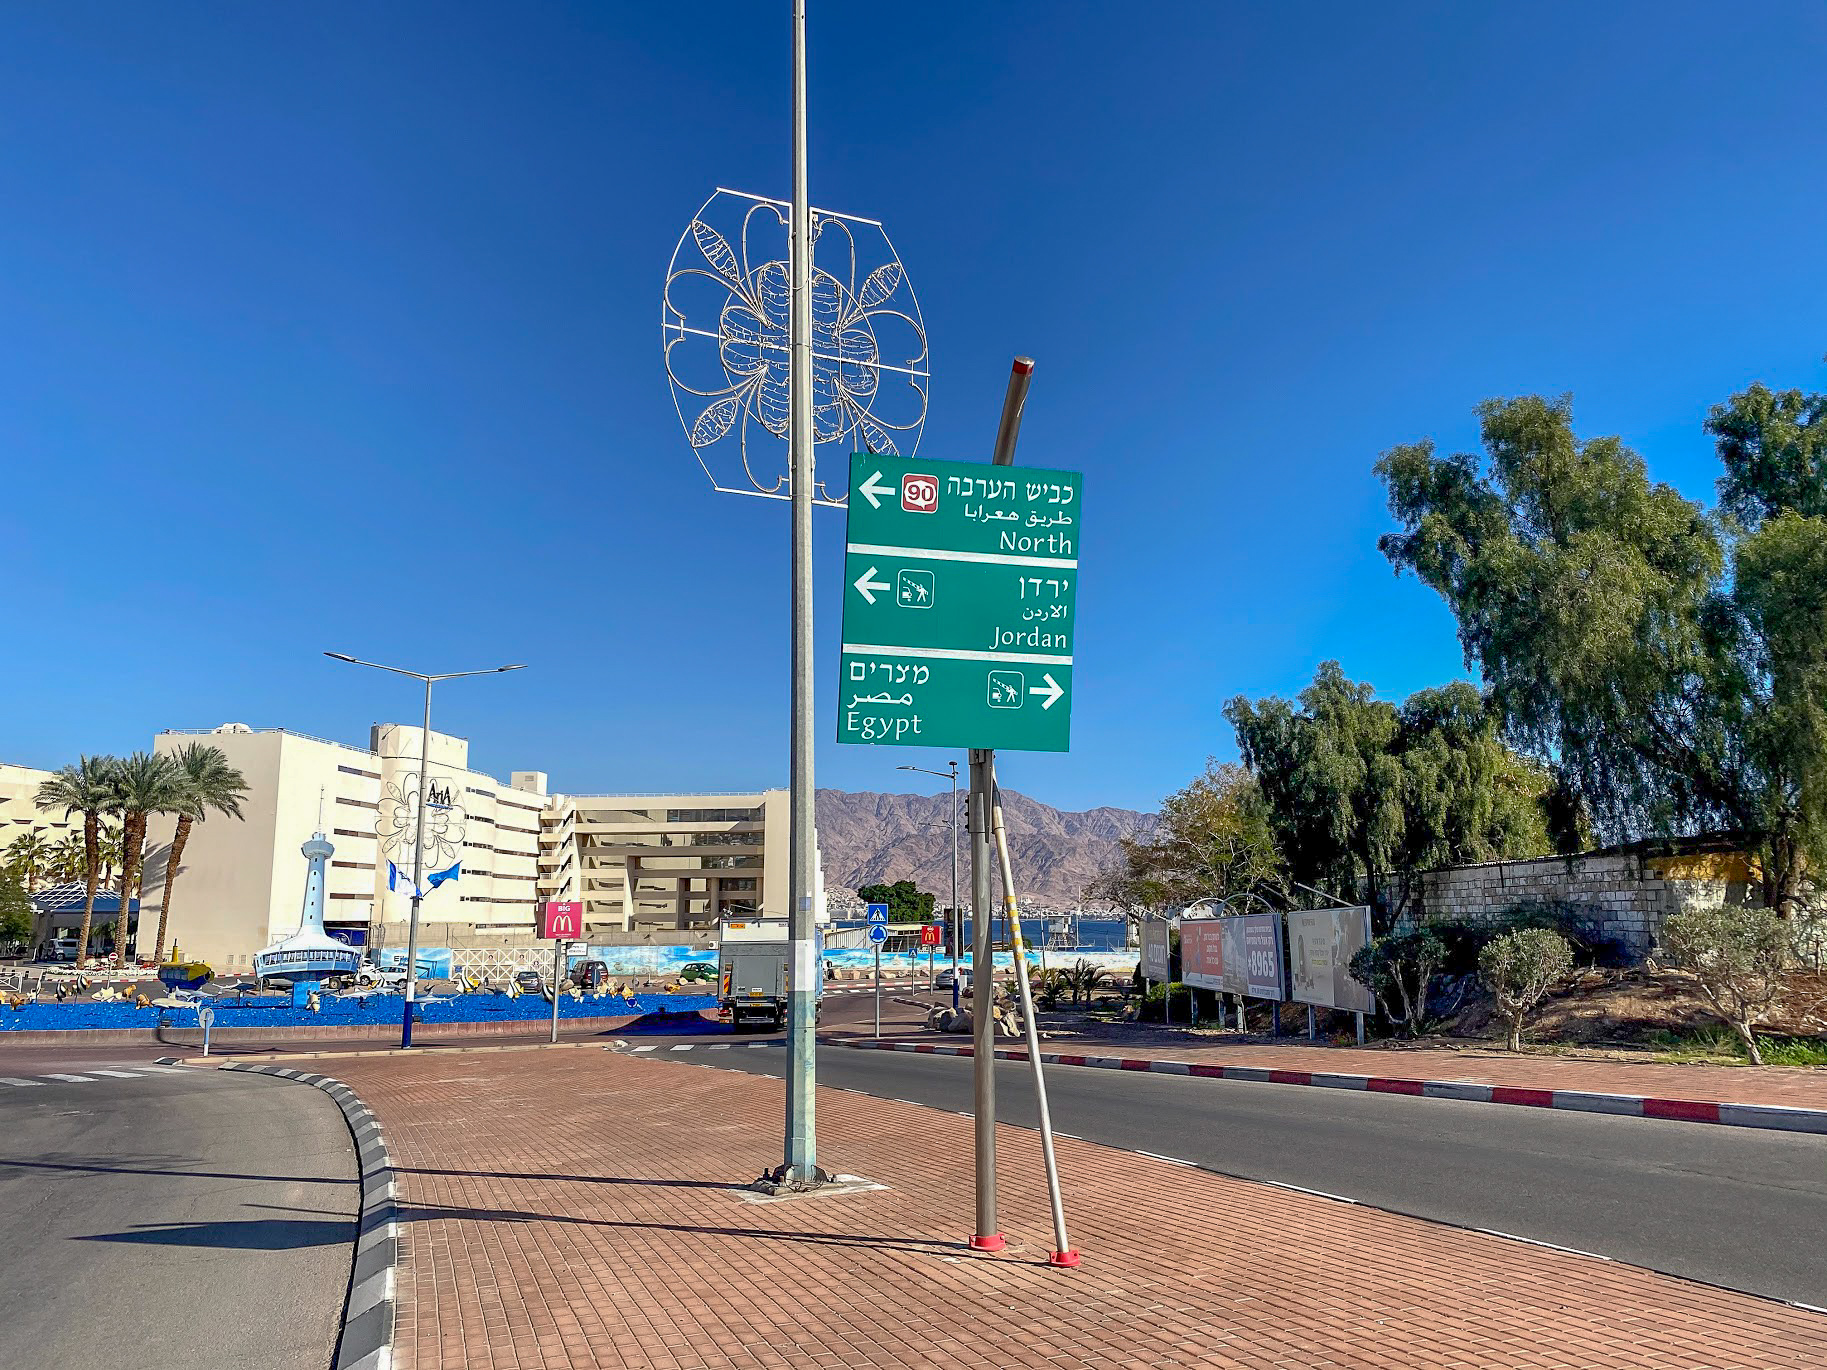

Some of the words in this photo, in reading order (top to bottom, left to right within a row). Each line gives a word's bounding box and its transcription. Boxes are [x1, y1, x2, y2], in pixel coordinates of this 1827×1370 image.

[907, 485, 935, 502] 90
[947, 475, 1016, 501] הערבה
[1026, 482, 1074, 505] כביש
[963, 503, 1020, 523] هعرابا
[1025, 510, 1073, 528] طريق
[1000, 530, 1072, 555] North
[1019, 576, 1069, 600] ירדן
[988, 625, 1067, 650] Jordan
[850, 660, 930, 685] מצרים
[846, 691, 914, 709] مصر
[847, 711, 923, 741] Egypt
